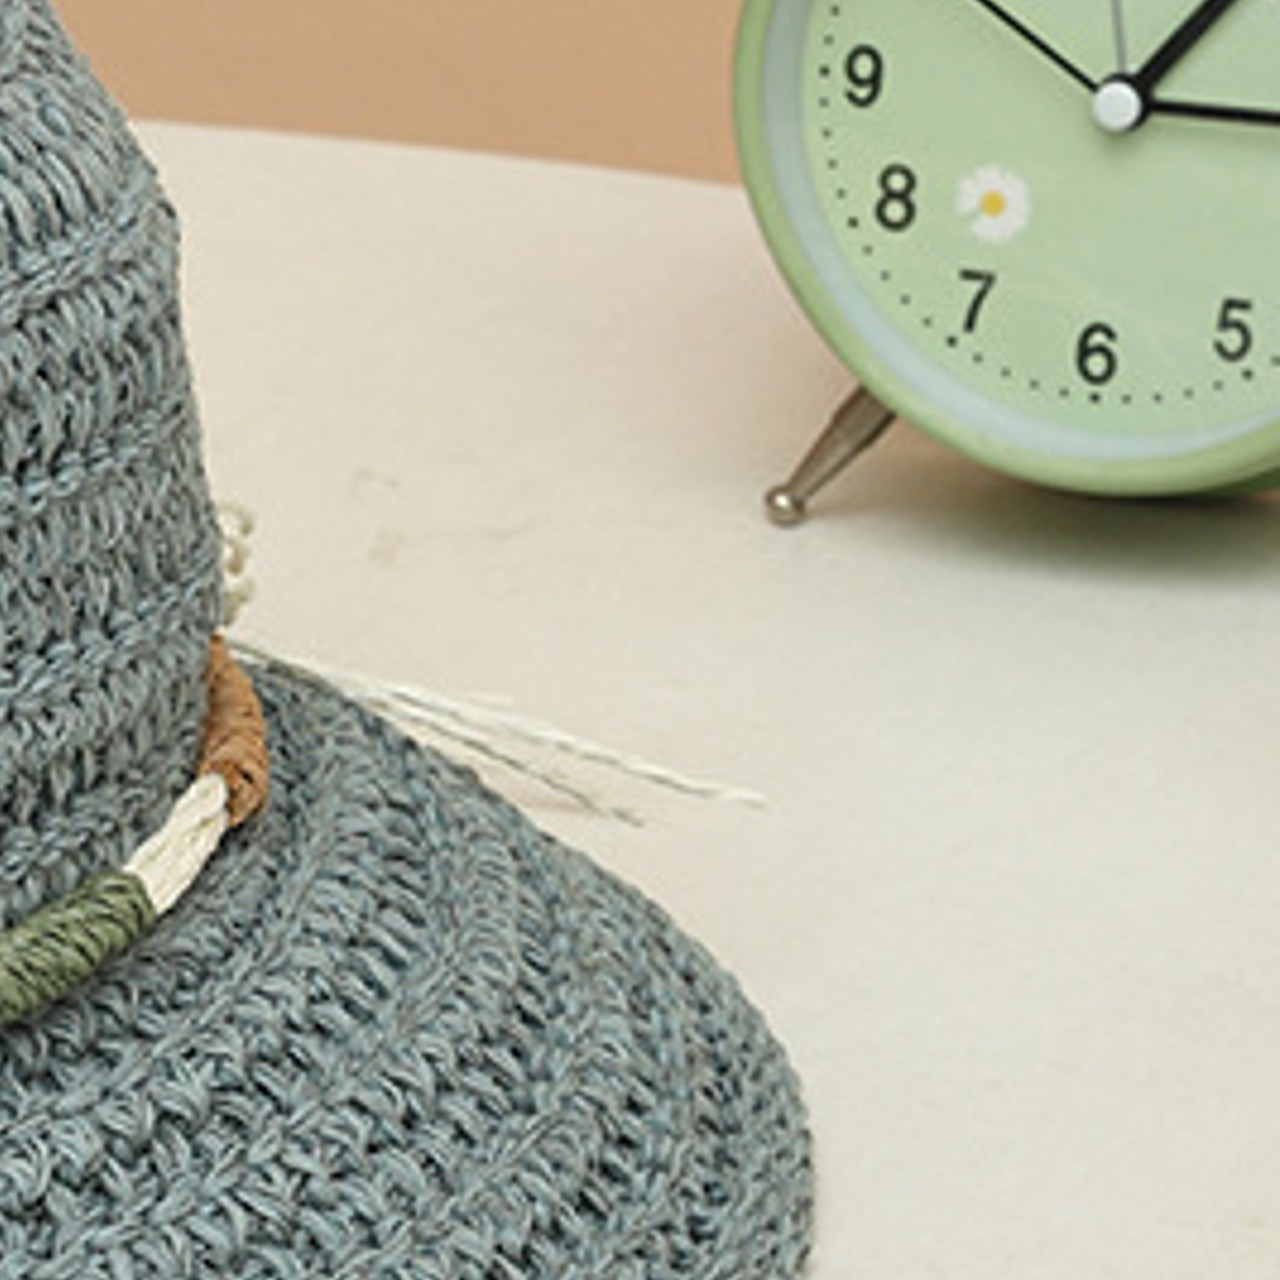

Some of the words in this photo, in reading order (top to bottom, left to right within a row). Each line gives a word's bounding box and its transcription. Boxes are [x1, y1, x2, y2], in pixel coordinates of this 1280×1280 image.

[844, 44, 884, 108] 9
[874, 163, 917, 232] 8
[959, 269, 996, 333] 7
[1214, 298, 1253, 363] 5
[1075, 321, 1118, 386] 6
